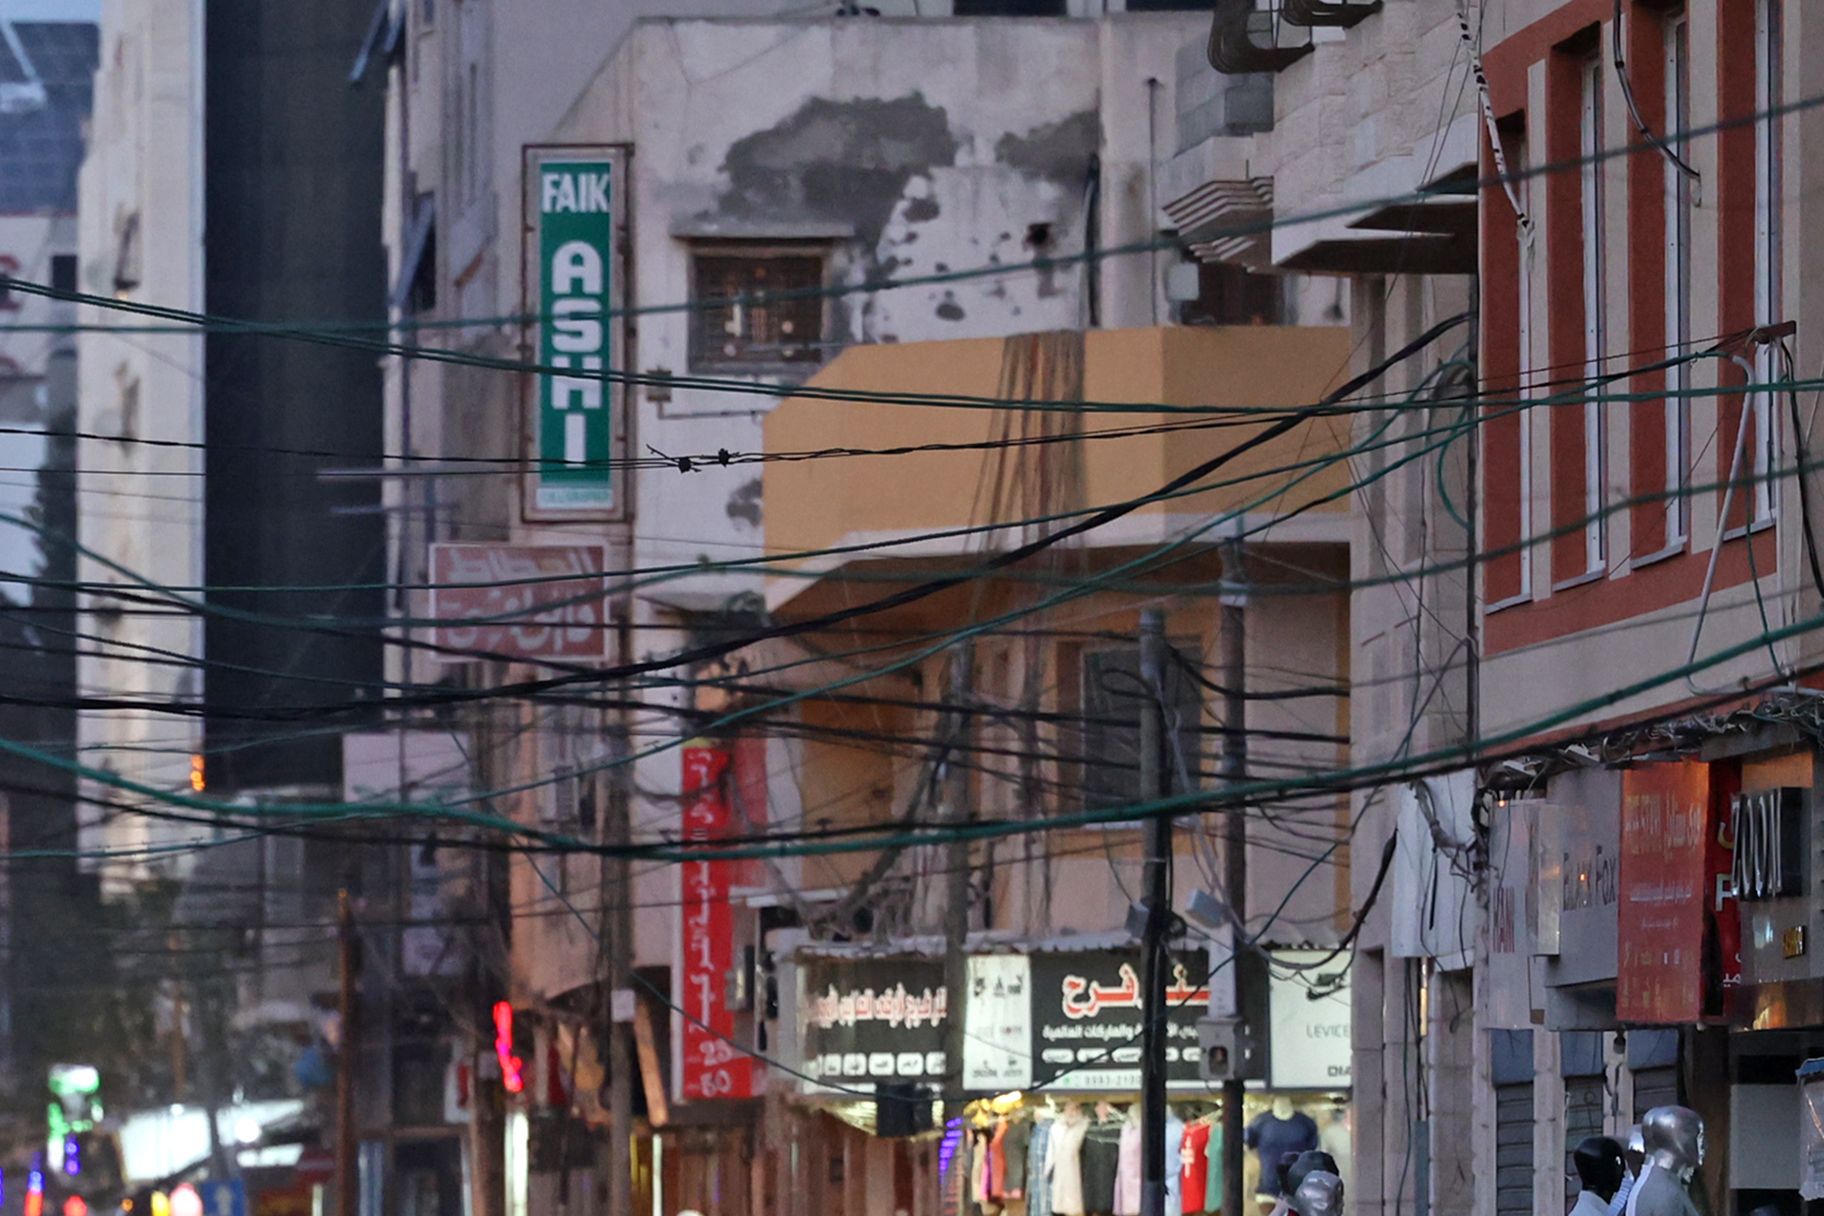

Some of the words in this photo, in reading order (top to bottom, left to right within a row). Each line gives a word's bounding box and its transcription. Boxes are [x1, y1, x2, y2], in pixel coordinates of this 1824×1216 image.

[541, 172, 611, 214] FAIK
[551, 240, 603, 469] ASHI
[1062, 962, 1140, 1019] فرح
